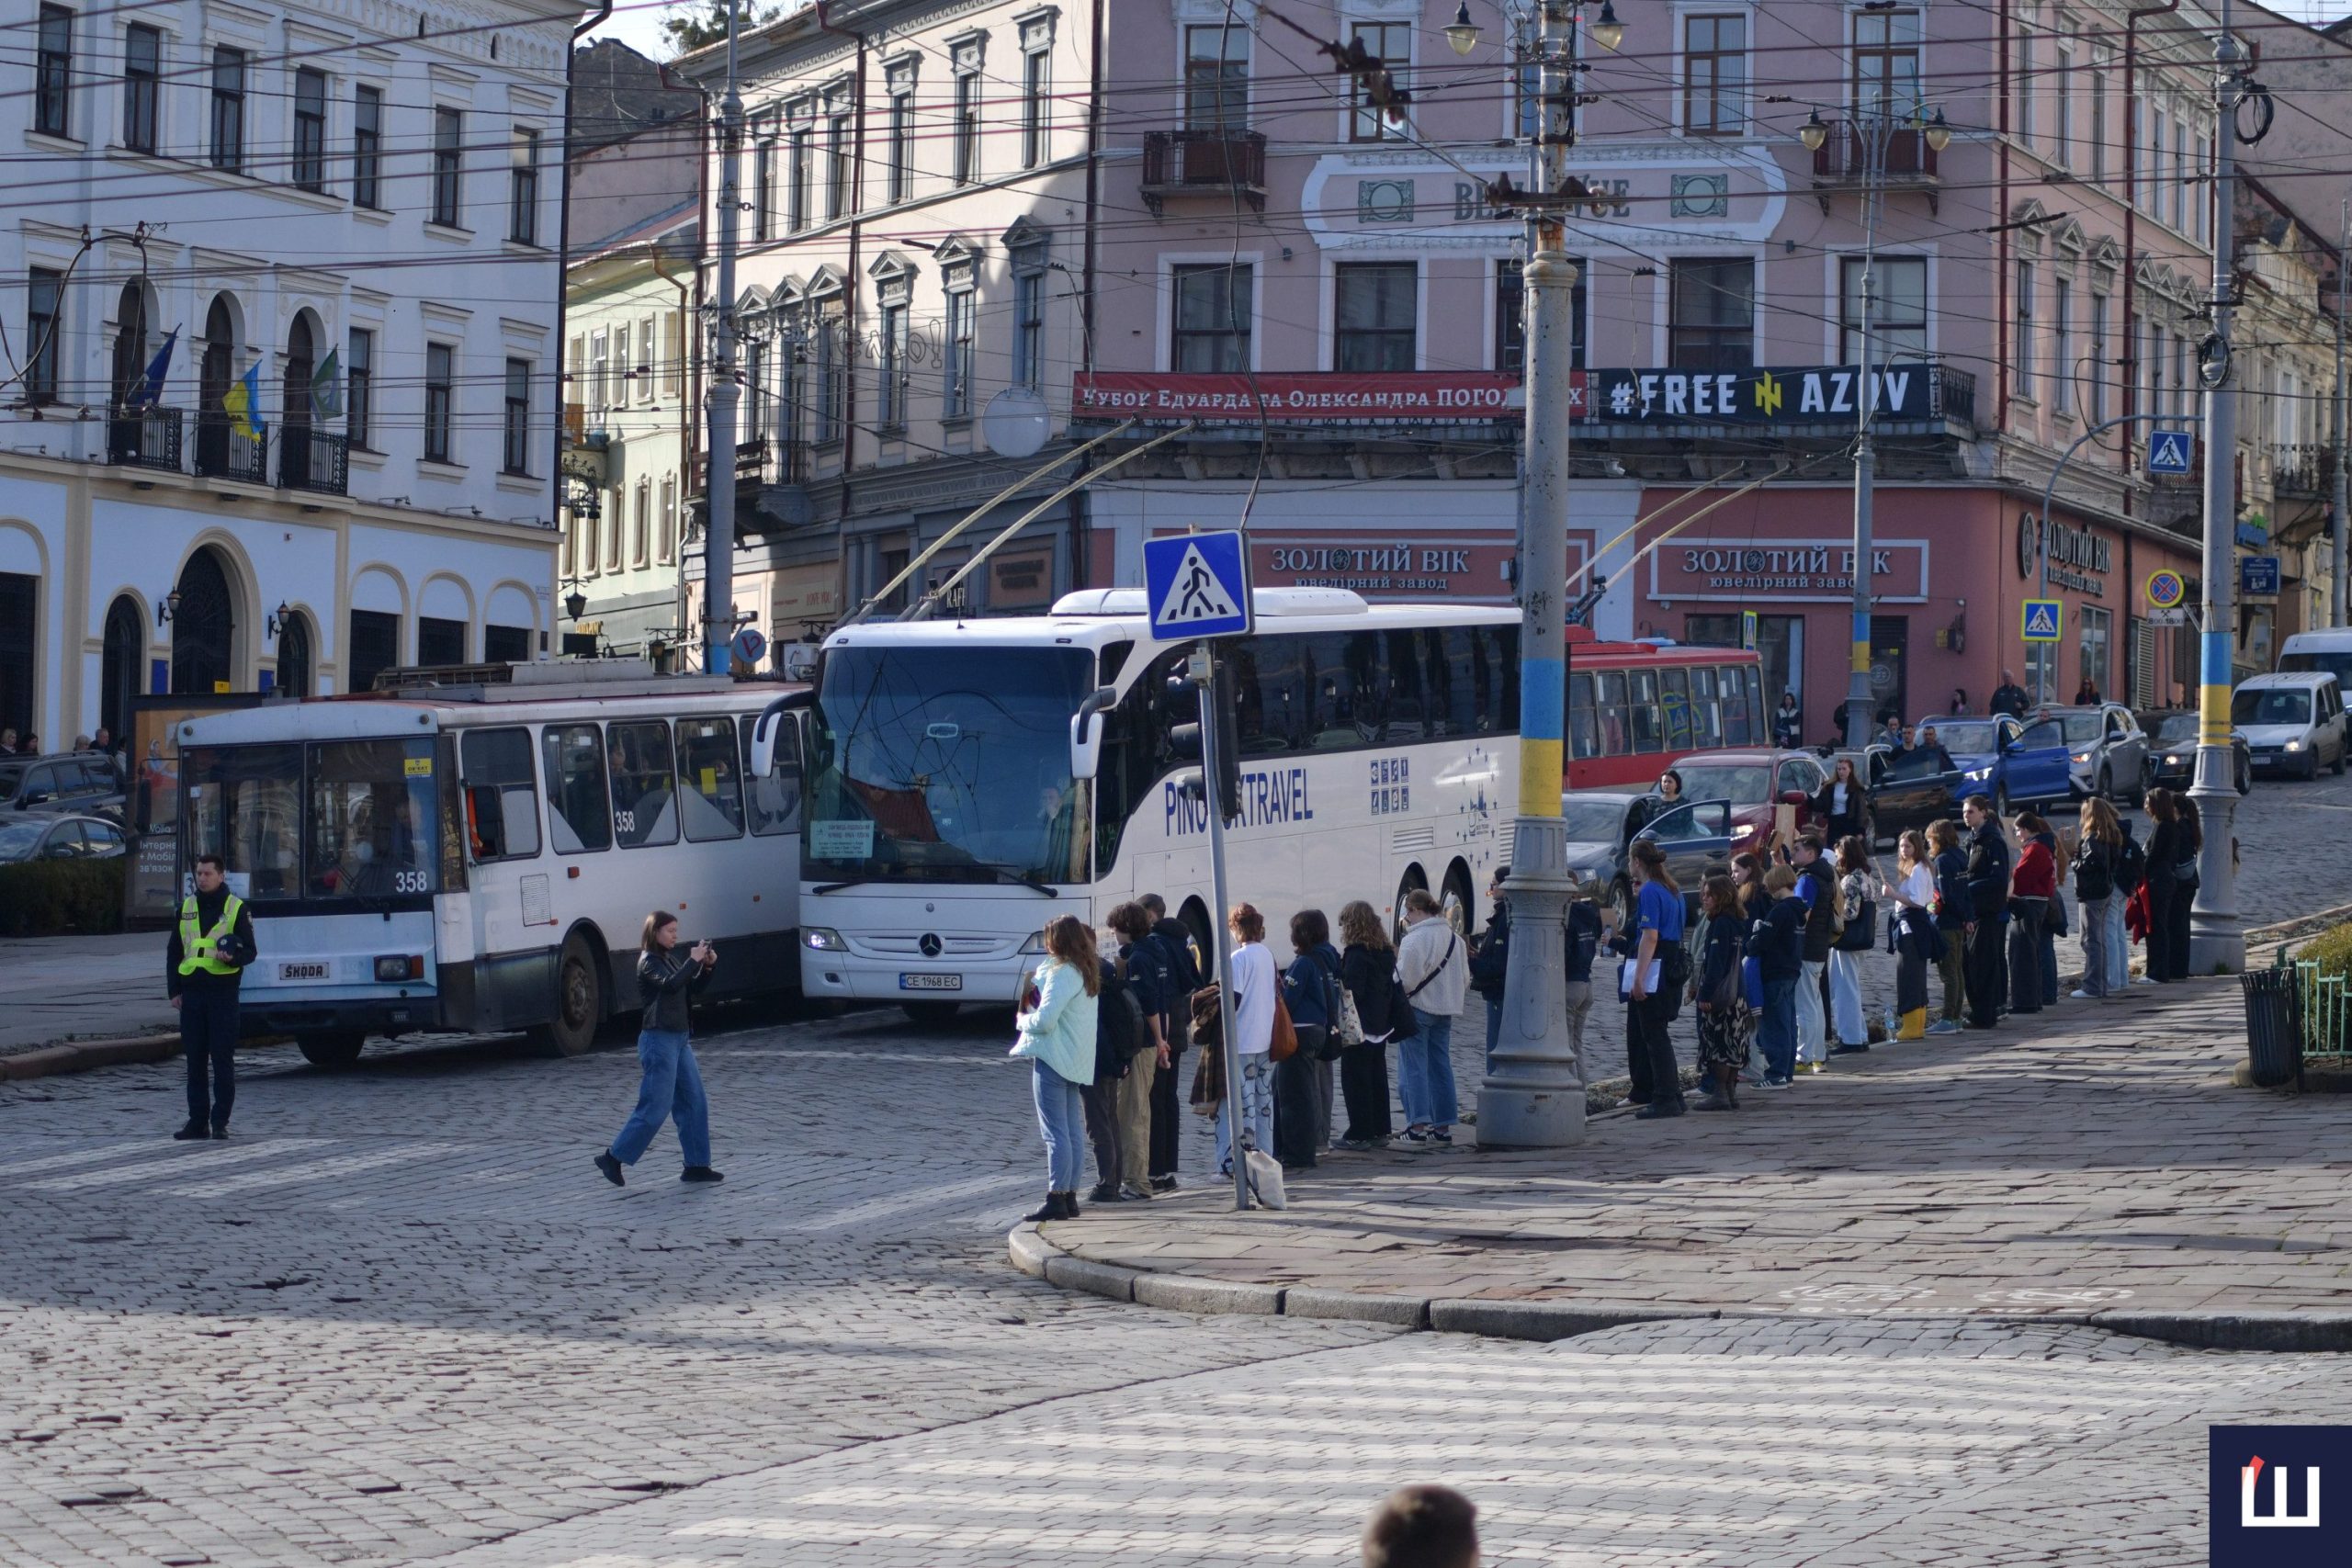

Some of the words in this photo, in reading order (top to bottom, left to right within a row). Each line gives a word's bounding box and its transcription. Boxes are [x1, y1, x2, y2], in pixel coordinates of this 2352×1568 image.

[1610, 374, 1737, 418] #FREE
[2048, 522, 2094, 569] ОЛОТИЙ
[1272, 544, 1411, 571] ЗОЛОТИЙ
[1422, 550, 1469, 572] ВІК
[1683, 546, 1828, 573] ЗОЛОТИЙ
[1841, 551, 1891, 574] ВК
[1295, 575, 1391, 589] ювелірний
[1397, 577, 1447, 589] завод
[1710, 574, 1809, 590] ювелірний
[1817, 576, 1854, 588] заво
[616, 811, 635, 832] 358
[140, 840, 176, 852] Інтерне
[147, 852, 176, 861] Мобіл
[395, 872, 428, 893] 358
[907, 976, 919, 987] CE
[922, 976, 943, 987] 1968
[944, 976, 958, 987] EC
